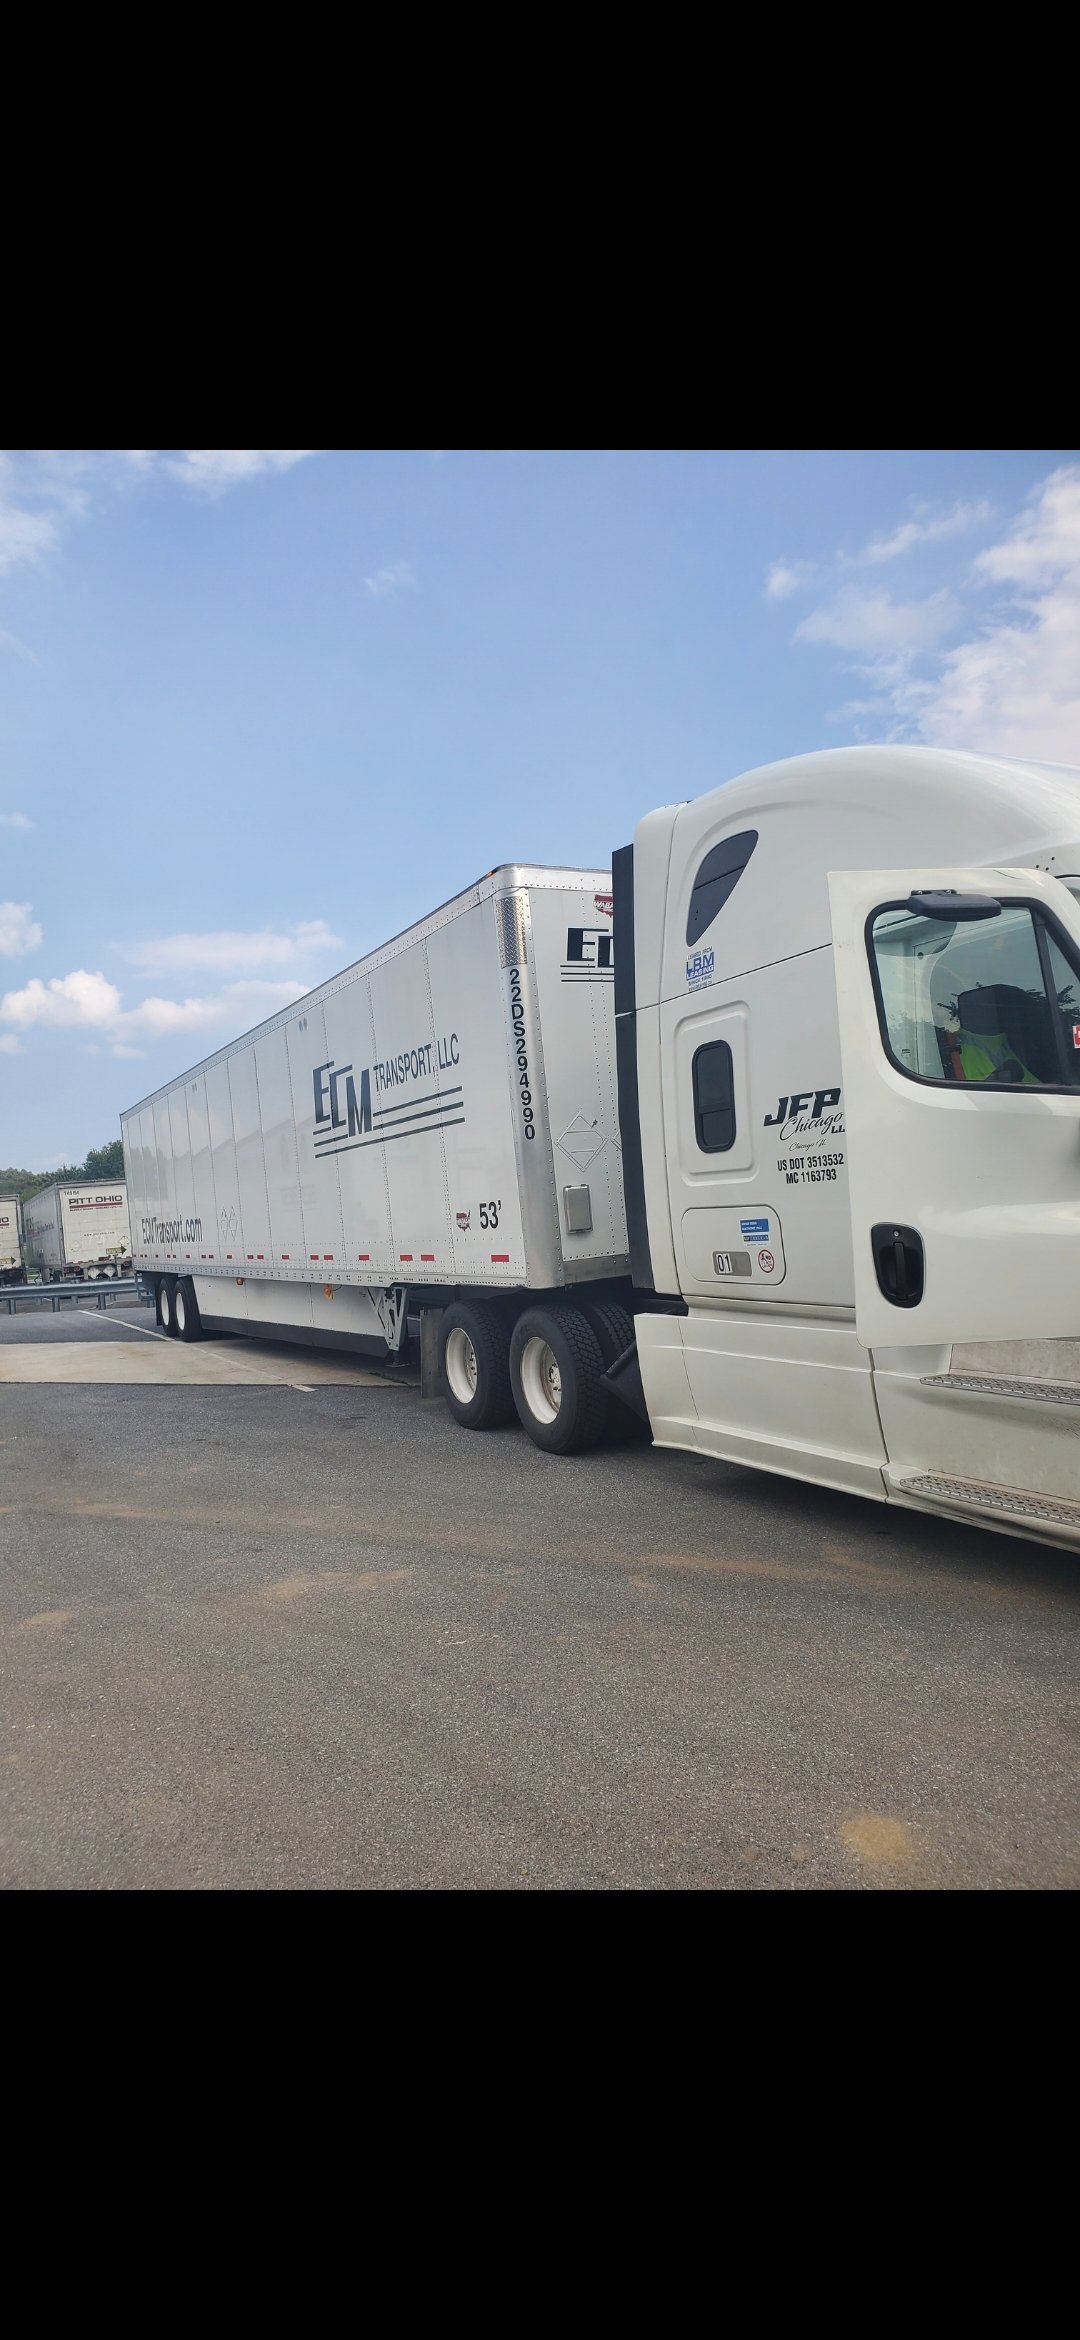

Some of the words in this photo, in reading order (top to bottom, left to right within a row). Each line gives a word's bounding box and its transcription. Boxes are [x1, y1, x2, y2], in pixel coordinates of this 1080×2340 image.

[509, 968, 536, 1140] 22DS294990
[313, 1060, 373, 1137] ECM
[437, 1033, 460, 1070] LLC
[764, 1087, 841, 1126] JFP
[780, 1112, 844, 1141] Chicago
[777, 1159, 788, 1171] US
[790, 1157, 805, 1170] DOT
[807, 1153, 844, 1168] 3513532
[786, 1172, 799, 1184] MC
[801, 1169, 837, 1182] 1163793
[68, 1197, 92, 1205] PITT
[95, 1195, 123, 1203] OHIO
[717, 1254, 731, 1272] 01
